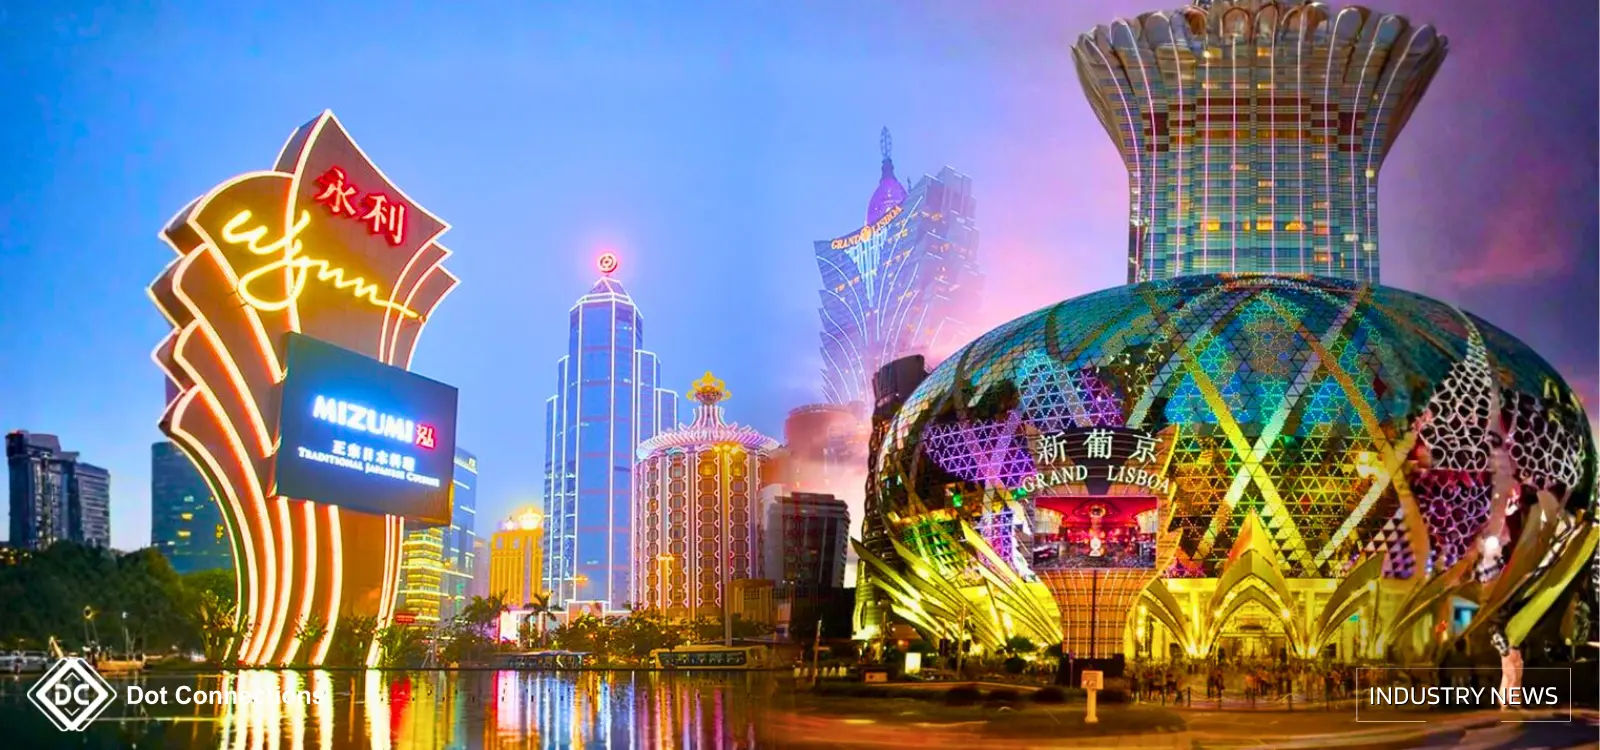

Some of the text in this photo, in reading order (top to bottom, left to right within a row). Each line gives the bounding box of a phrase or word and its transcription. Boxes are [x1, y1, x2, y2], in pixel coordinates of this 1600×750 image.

[315, 165, 405, 245] 永利
[222, 209, 421, 318] Wynn
[312, 395, 415, 444] MIZUMI
[1036, 427, 1164, 466] 新葡京
[1022, 464, 1170, 494] GRAND LISBOA
